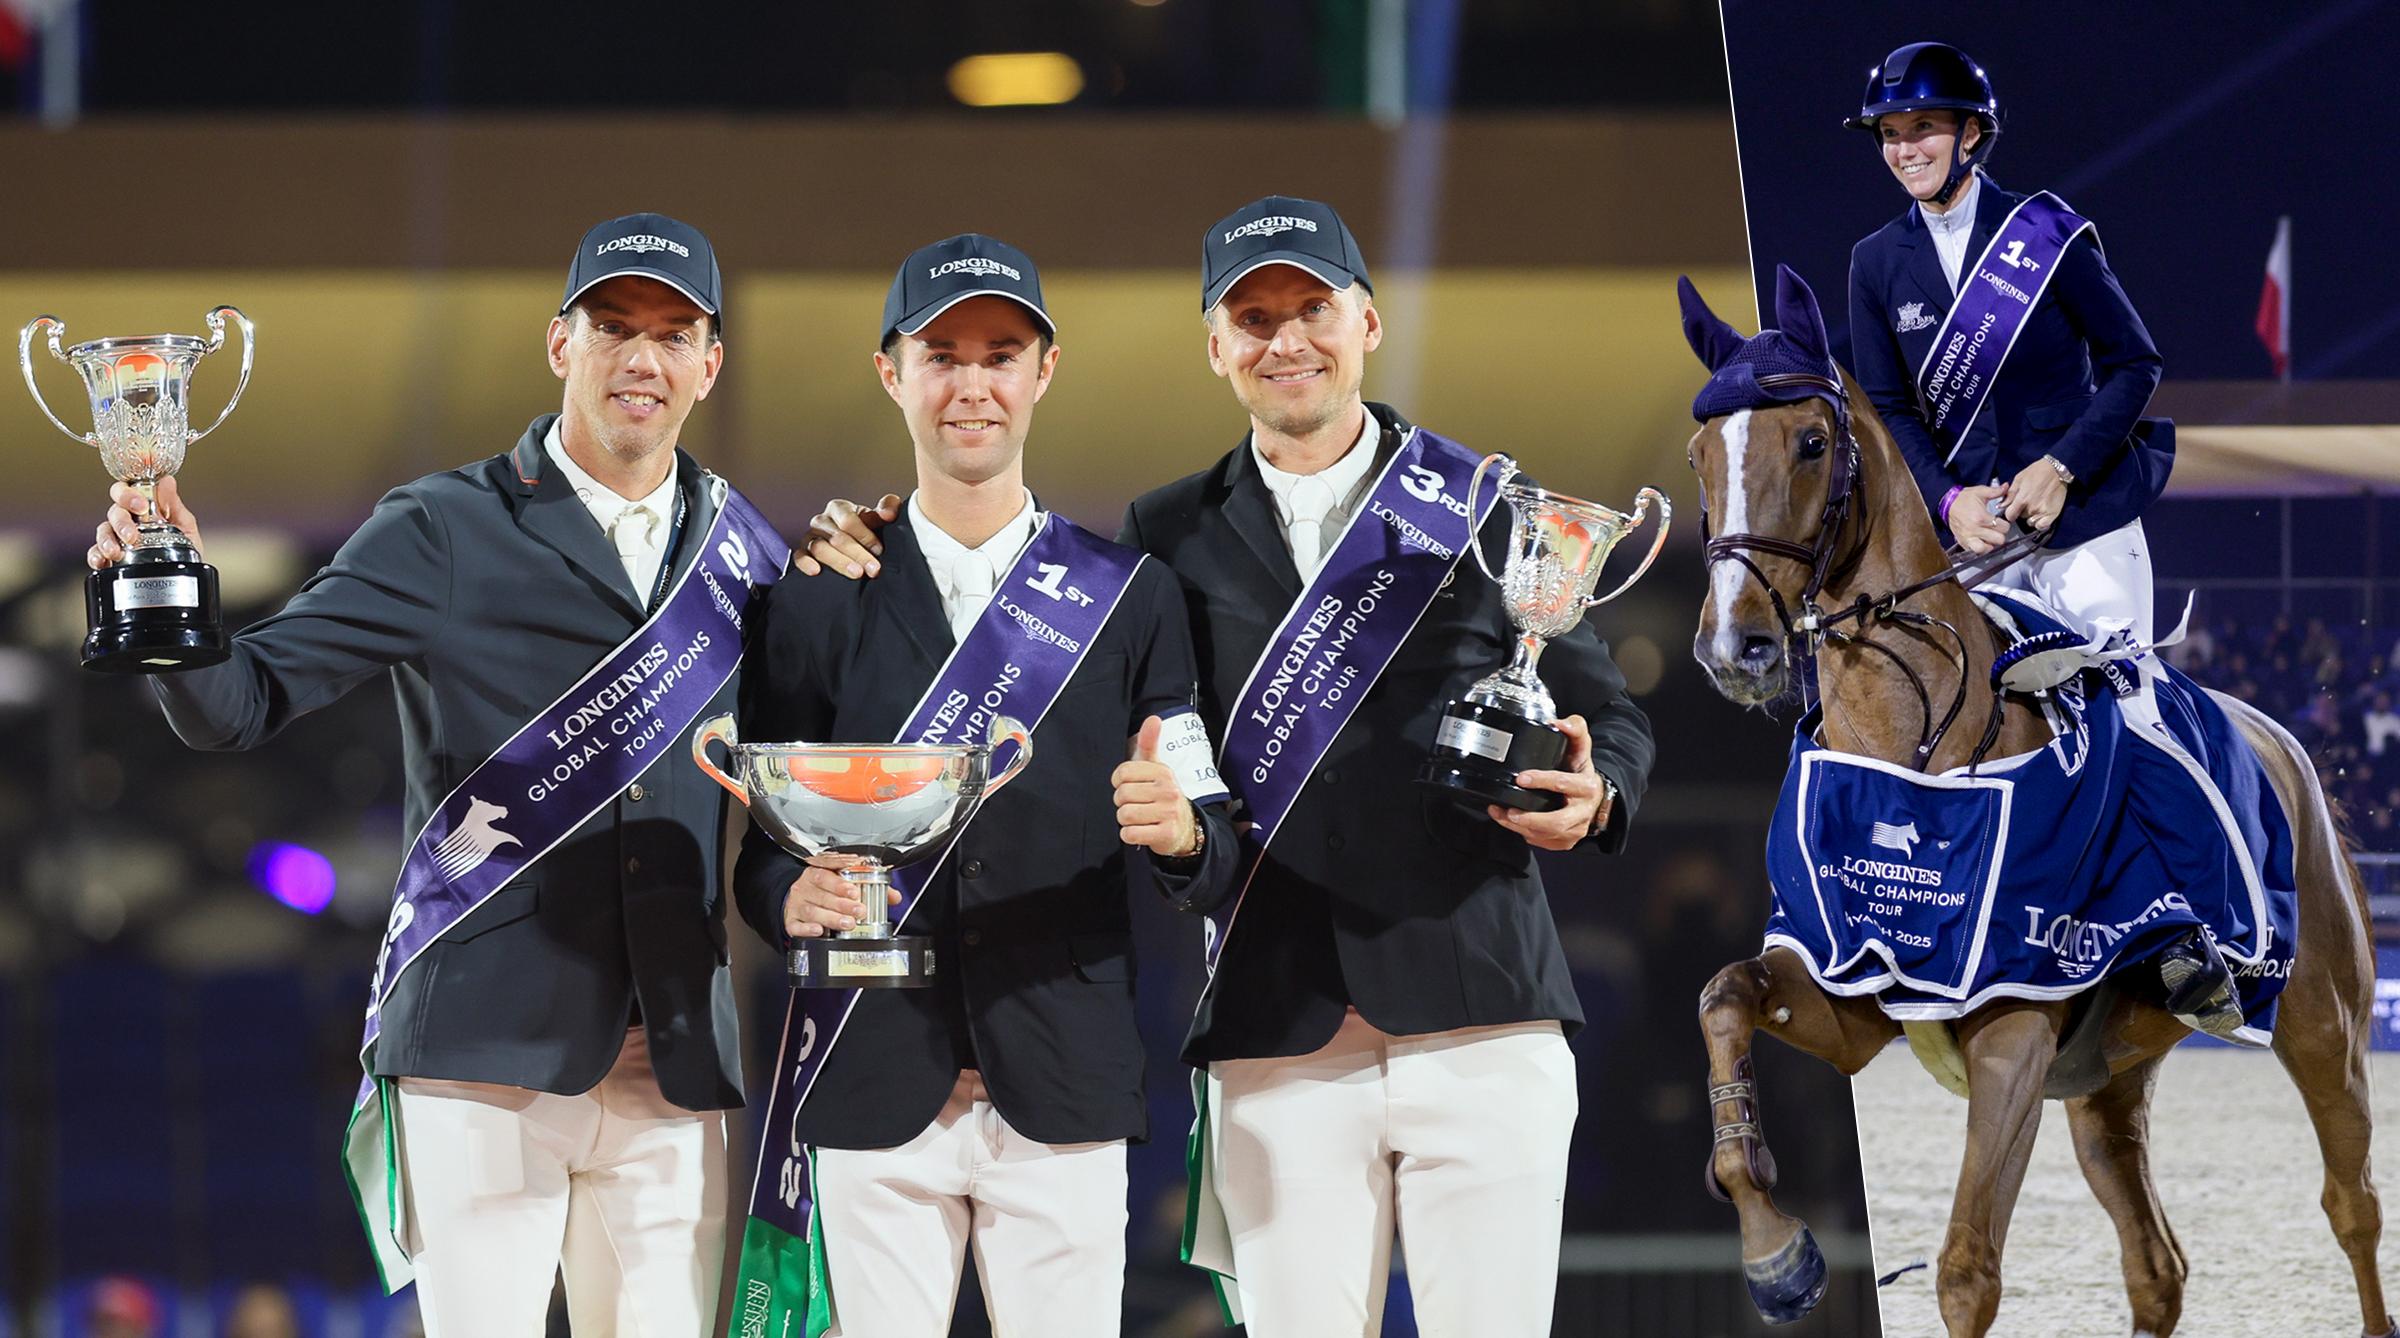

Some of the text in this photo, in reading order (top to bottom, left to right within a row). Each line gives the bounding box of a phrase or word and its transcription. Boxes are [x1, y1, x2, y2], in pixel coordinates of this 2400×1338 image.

[597, 235, 689, 258] LONGINES
[1224, 216, 1318, 244] LONGINES
[929, 258, 1021, 281] LONGINES
[1999, 239, 2041, 272] 1ST
[1979, 268, 2031, 305] LONGINES
[1926, 331, 1967, 403] LONGINES
[1950, 312, 1996, 390] CHAMPIONS
[1963, 374, 1981, 400] TOUR
[1400, 464, 1470, 518] 3RD
[1370, 501, 1454, 561] LONGINES
[1025, 561, 1095, 608] 1ST
[997, 594, 1081, 654] LONGINES
[1251, 595, 1344, 728] LONGINES
[1252, 568, 1395, 785] GLOBAL CHAMPIONS
[546, 641, 670, 751] LONGINES
[1319, 664, 1360, 710] TOUR
[527, 630, 712, 802] GLOBAL CHAMPIONS
[623, 717, 666, 757] TOUR
[1819, 864, 1966, 907] GLOBAL CHAMPIONS
[1842, 855, 1942, 887] LONGINES
[1867, 901, 1903, 916] TOUR
[1895, 930, 1932, 948] 2025
